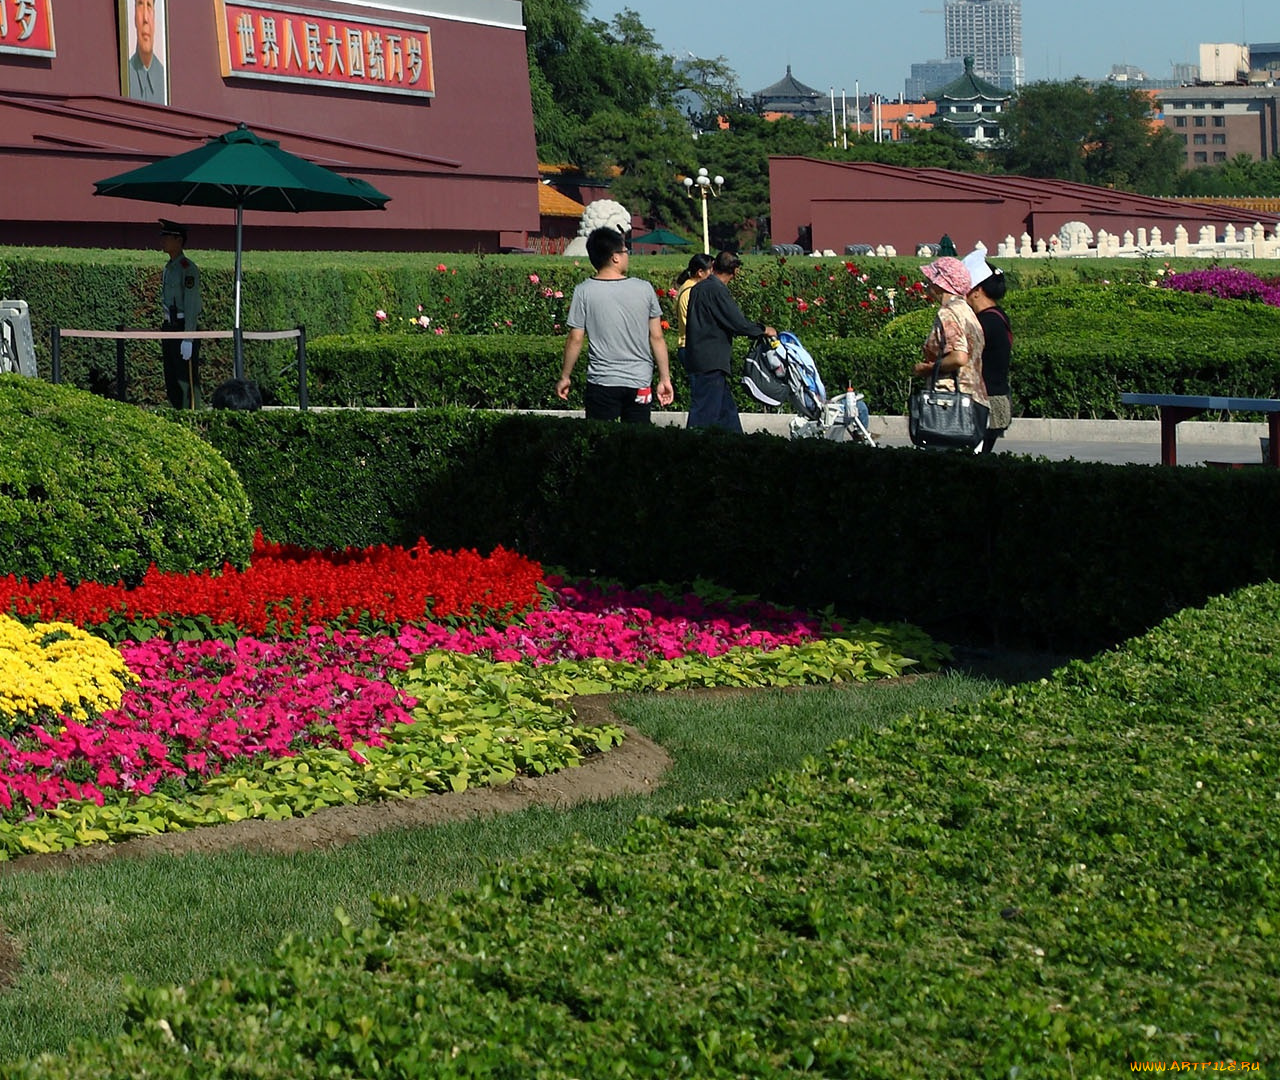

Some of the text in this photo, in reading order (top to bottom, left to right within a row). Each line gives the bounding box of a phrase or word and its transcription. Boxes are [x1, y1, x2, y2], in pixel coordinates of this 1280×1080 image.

[237, 13, 422, 84] 世界人民大团结万岁
